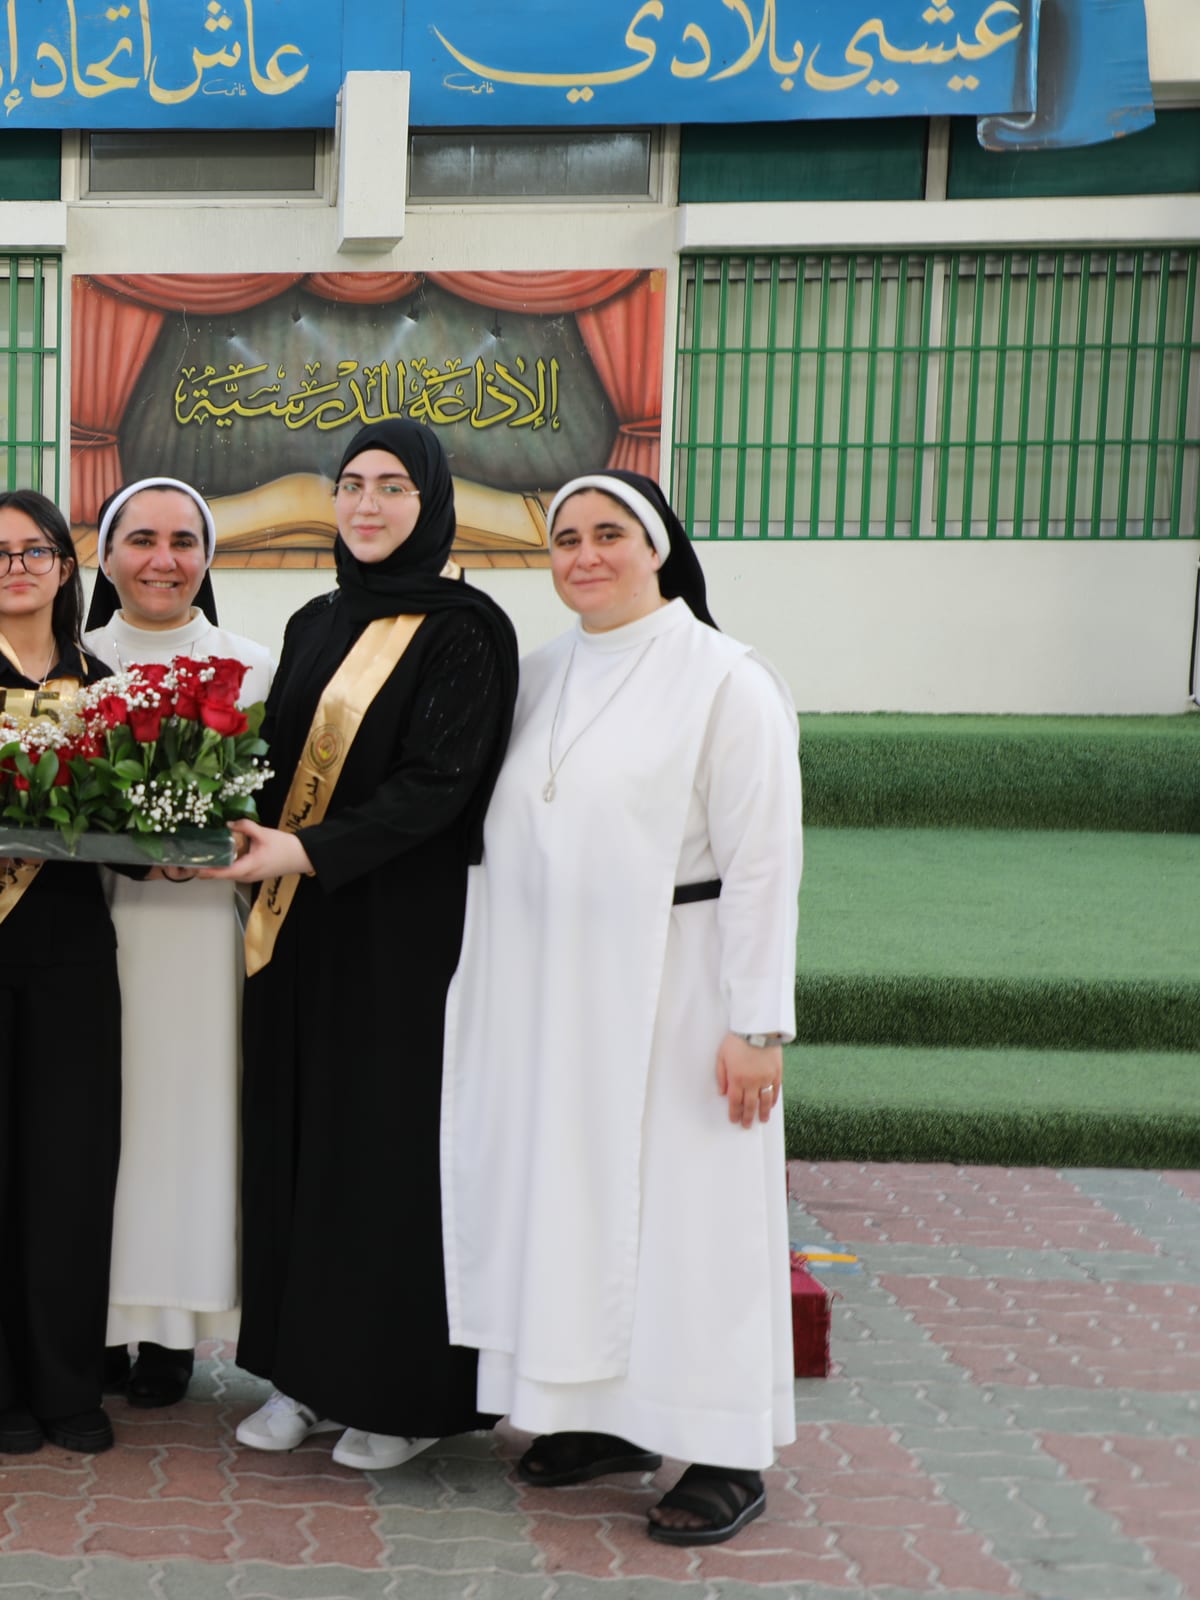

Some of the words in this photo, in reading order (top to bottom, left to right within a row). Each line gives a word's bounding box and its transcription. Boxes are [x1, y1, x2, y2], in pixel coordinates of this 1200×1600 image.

[30, 0, 151, 98] اتحاد
[149, 0, 309, 104] عاش
[433, 0, 804, 103] بلادي
[804, 0, 1023, 96] عيشي
